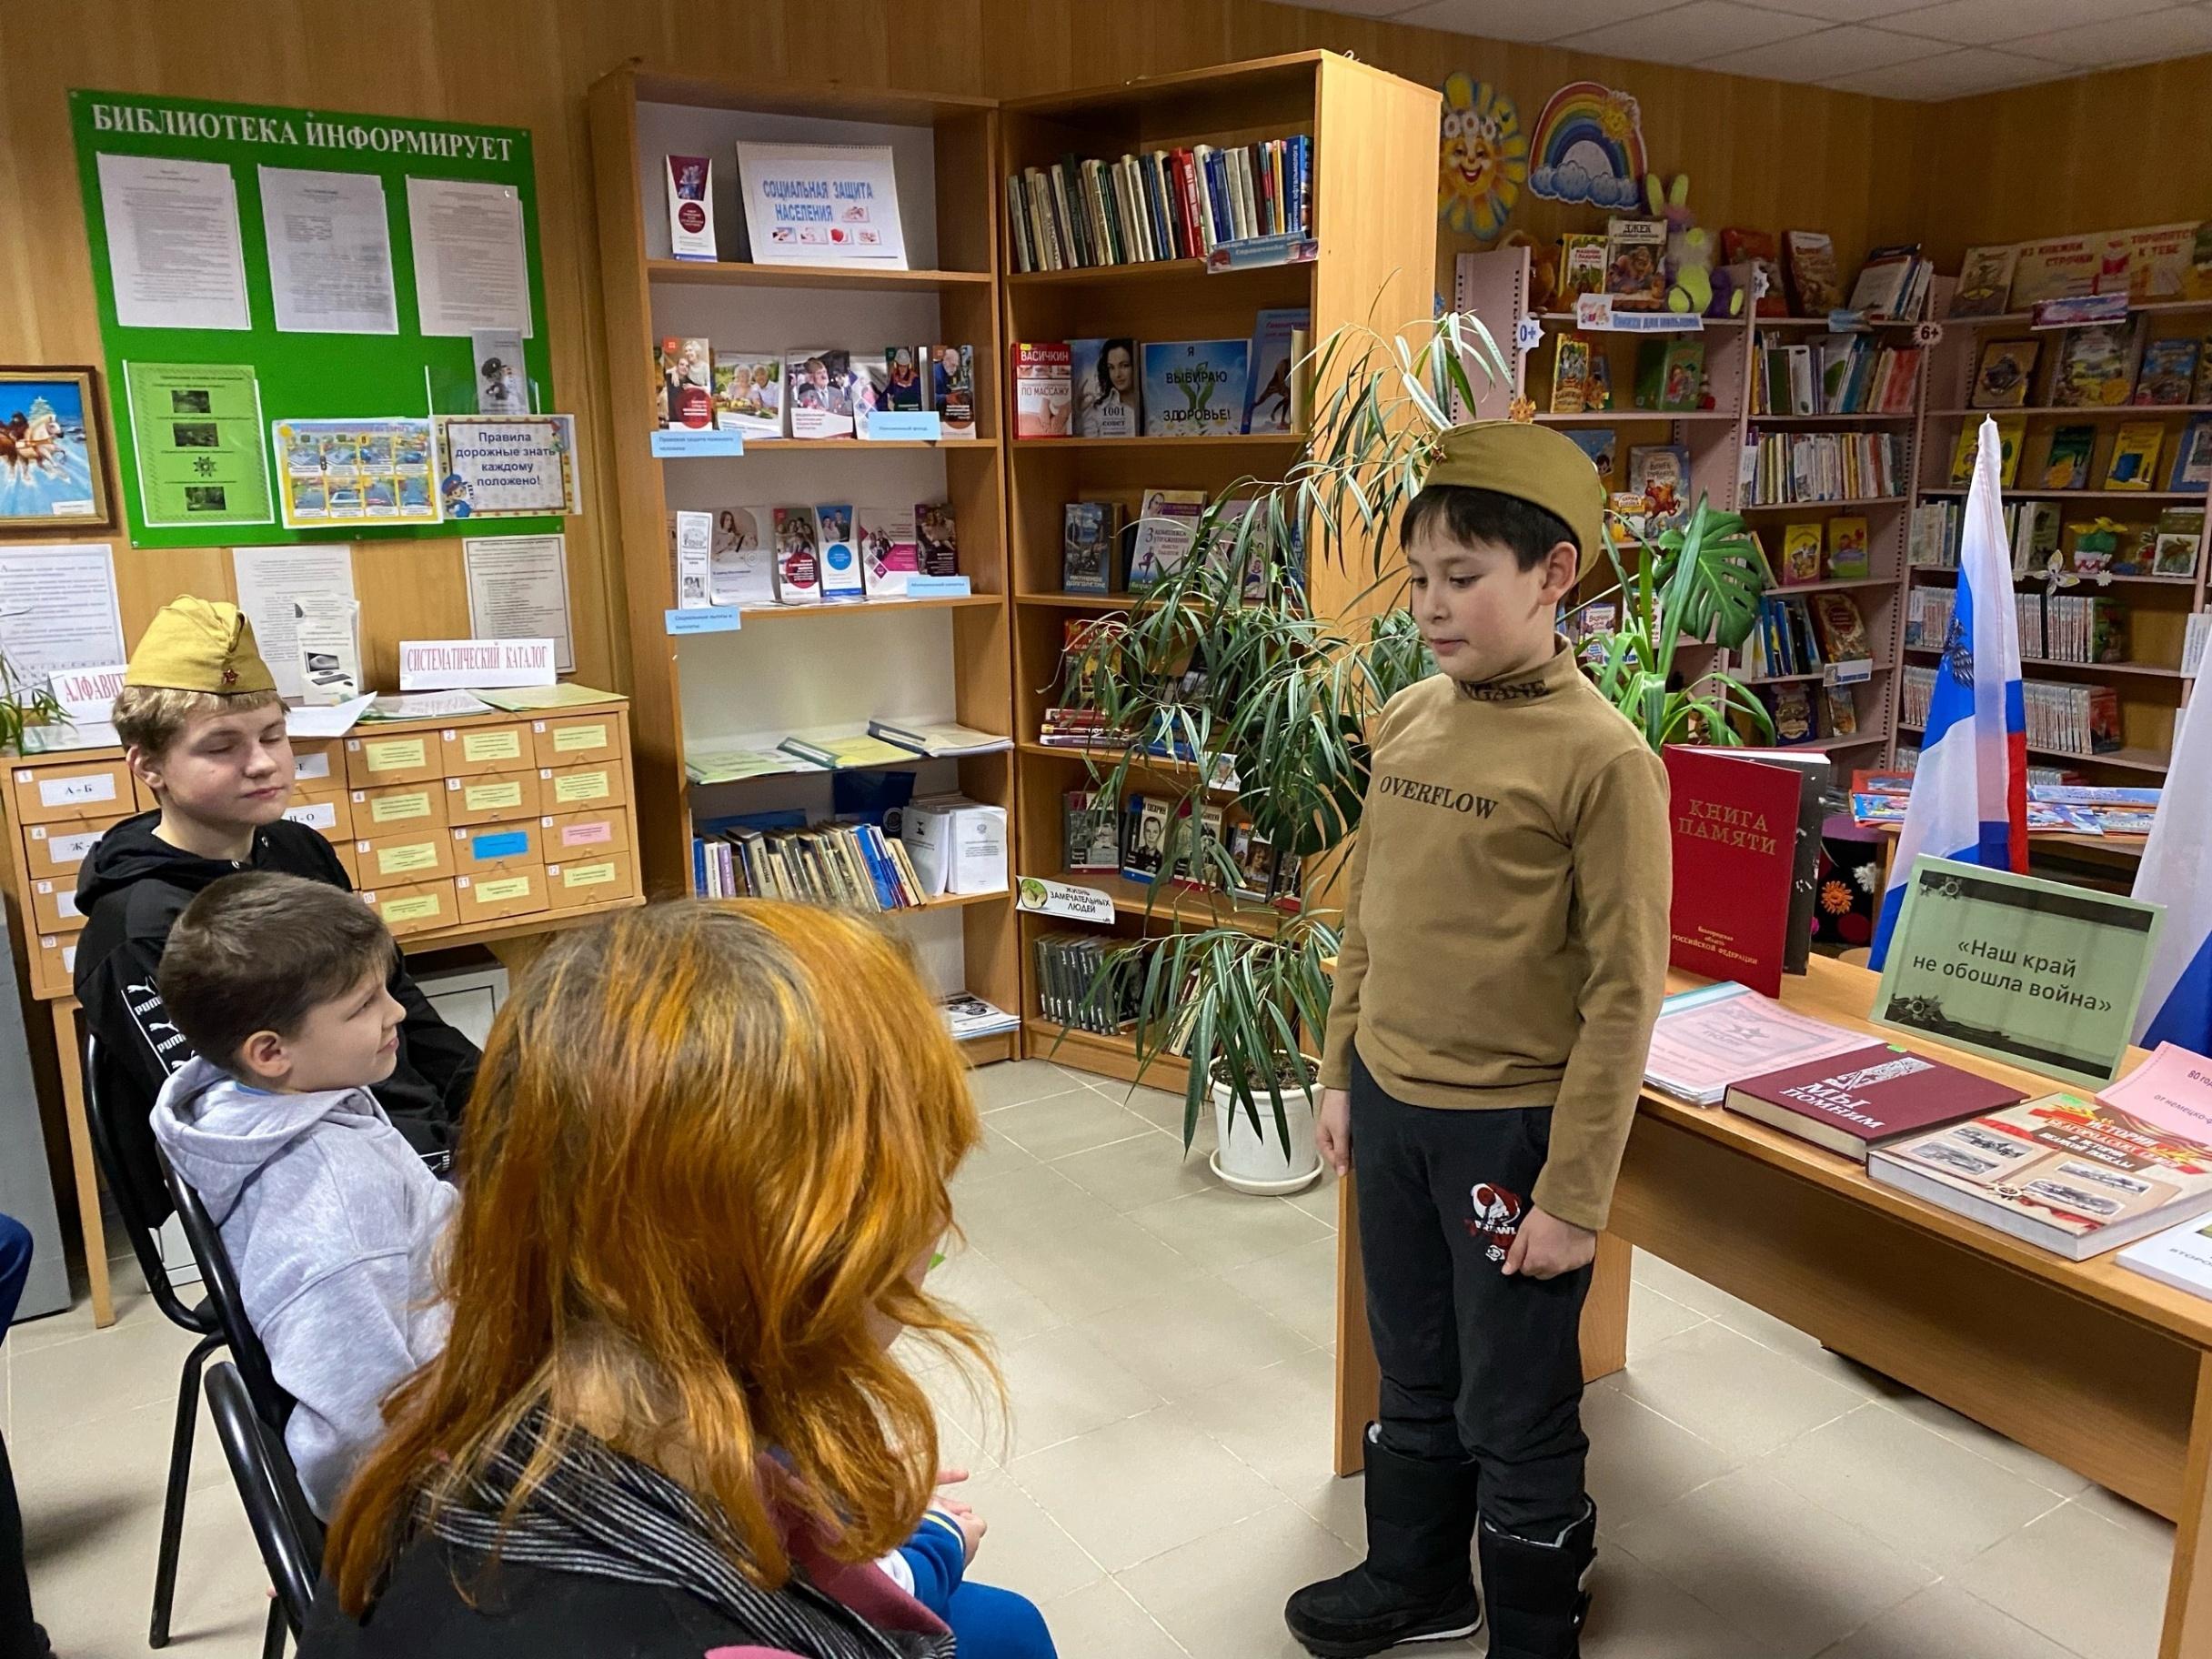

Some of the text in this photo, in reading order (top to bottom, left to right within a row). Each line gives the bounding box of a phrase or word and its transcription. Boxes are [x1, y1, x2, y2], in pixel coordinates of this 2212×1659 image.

[92, 104, 512, 162] БИБЛИОТЕКА ИНФОРМИРУЕТ
[762, 180, 873, 201] СОЦИАЛЬНАЯ ЗАЩИТА
[775, 204, 833, 222] НАСЕЛЕНИЯ
[1623, 224, 1651, 234] ДЖЕК
[1520, 324, 1536, 342] 0+
[1921, 326, 1939, 340] 6+
[1021, 350, 1069, 362] ВАСИЧКИН
[1187, 347, 1194, 357] Я
[1166, 370, 1228, 384] ВЫБИРАЮ
[1021, 387, 1070, 397] ПО МАССАЖУ
[1102, 407, 1125, 417] 1001
[1163, 409, 1231, 422] ЗДОРОВЬЕ!
[478, 432, 531, 444] Правила
[456, 448, 519, 458] дорожные
[482, 462, 534, 473] каждому
[477, 475, 540, 487] положено!
[1145, 528, 1153, 543] 3
[407, 642, 548, 671] СИСТЕМАТИЧЕСКИЙ КАТАЛОГ
[1380, 776, 1499, 819] OVERFLOW
[1689, 799, 1768, 833] КНИГА
[1677, 817, 1776, 856] ПАМЯТИ
[1050, 891, 1111, 907] ЗАМЕЧАТЕЛЬНЫХ
[1958, 940, 2076, 978] «Наш край
[1913, 955, 2112, 1012] не обошла война»
[1797, 1082, 1871, 1108] МЫ
[1779, 1088, 1885, 1129] ПОМНИМ
[2169, 1248, 2212, 1266] ВТОРО
